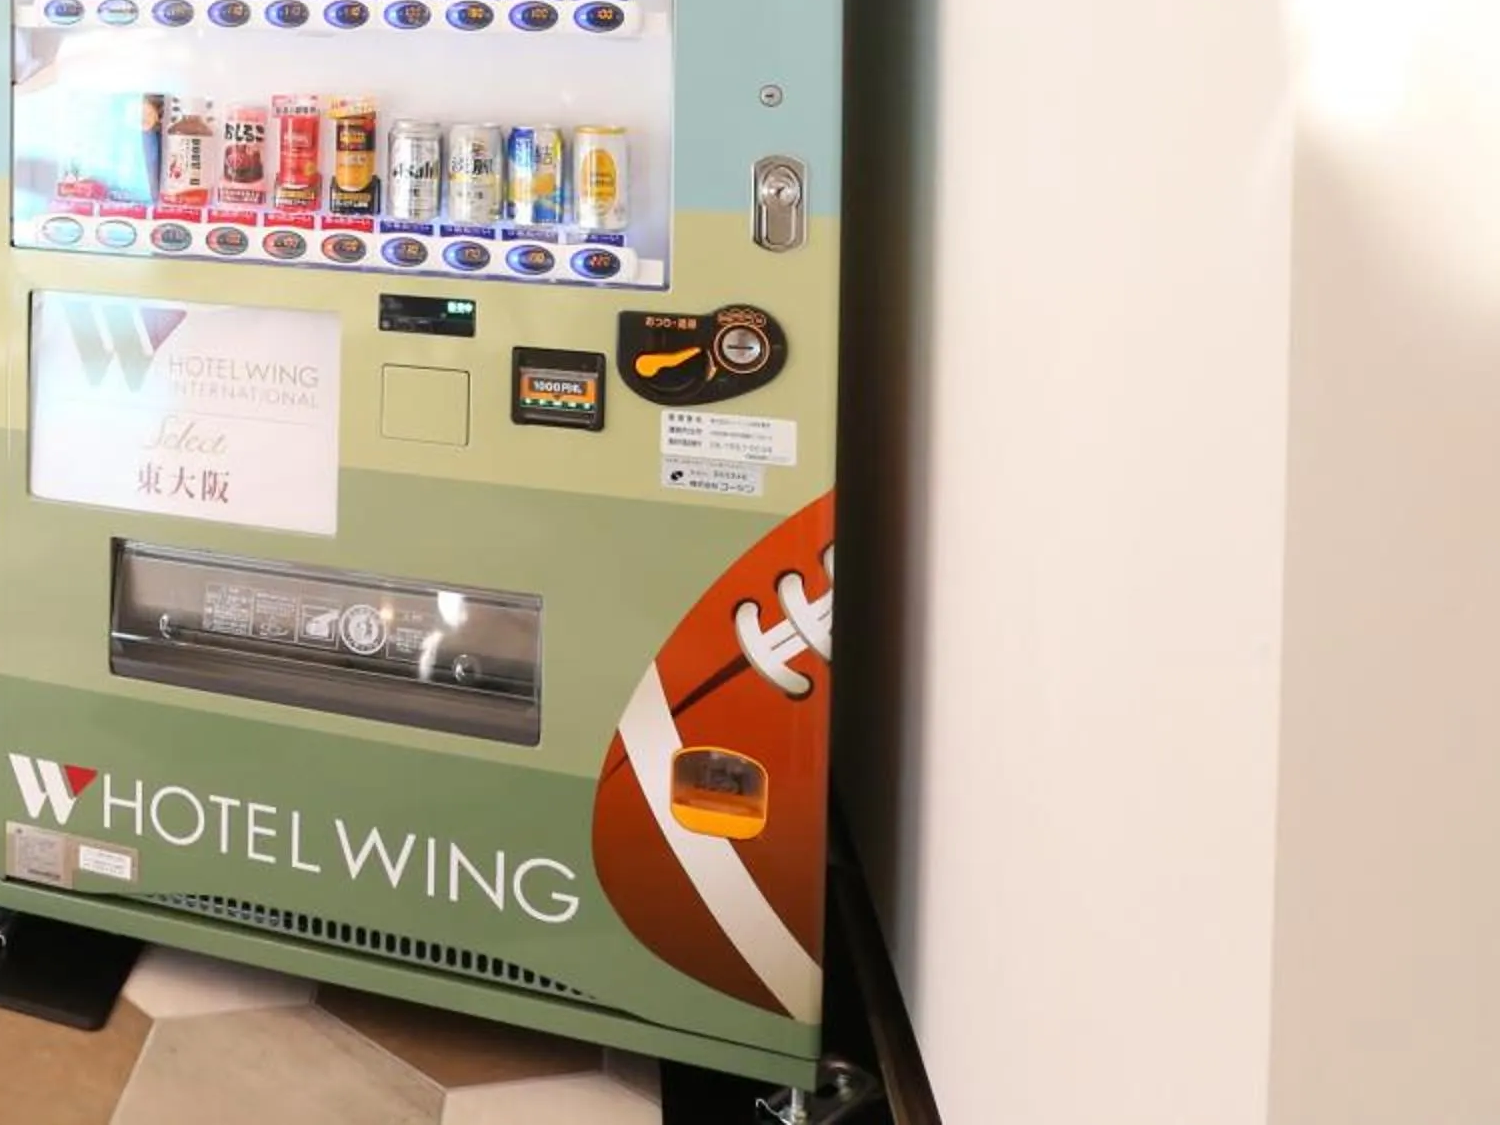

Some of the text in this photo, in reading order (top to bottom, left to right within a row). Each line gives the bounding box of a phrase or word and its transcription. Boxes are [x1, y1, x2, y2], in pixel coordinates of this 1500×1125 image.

[169, 353, 319, 388] HOTEL WING
[172, 380, 319, 409] INTERNATIONAL
[142, 415, 228, 455] Select
[137, 461, 231, 504] 東大阪
[103, 773, 321, 874] HOTEL
[335, 818, 579, 923] WING
